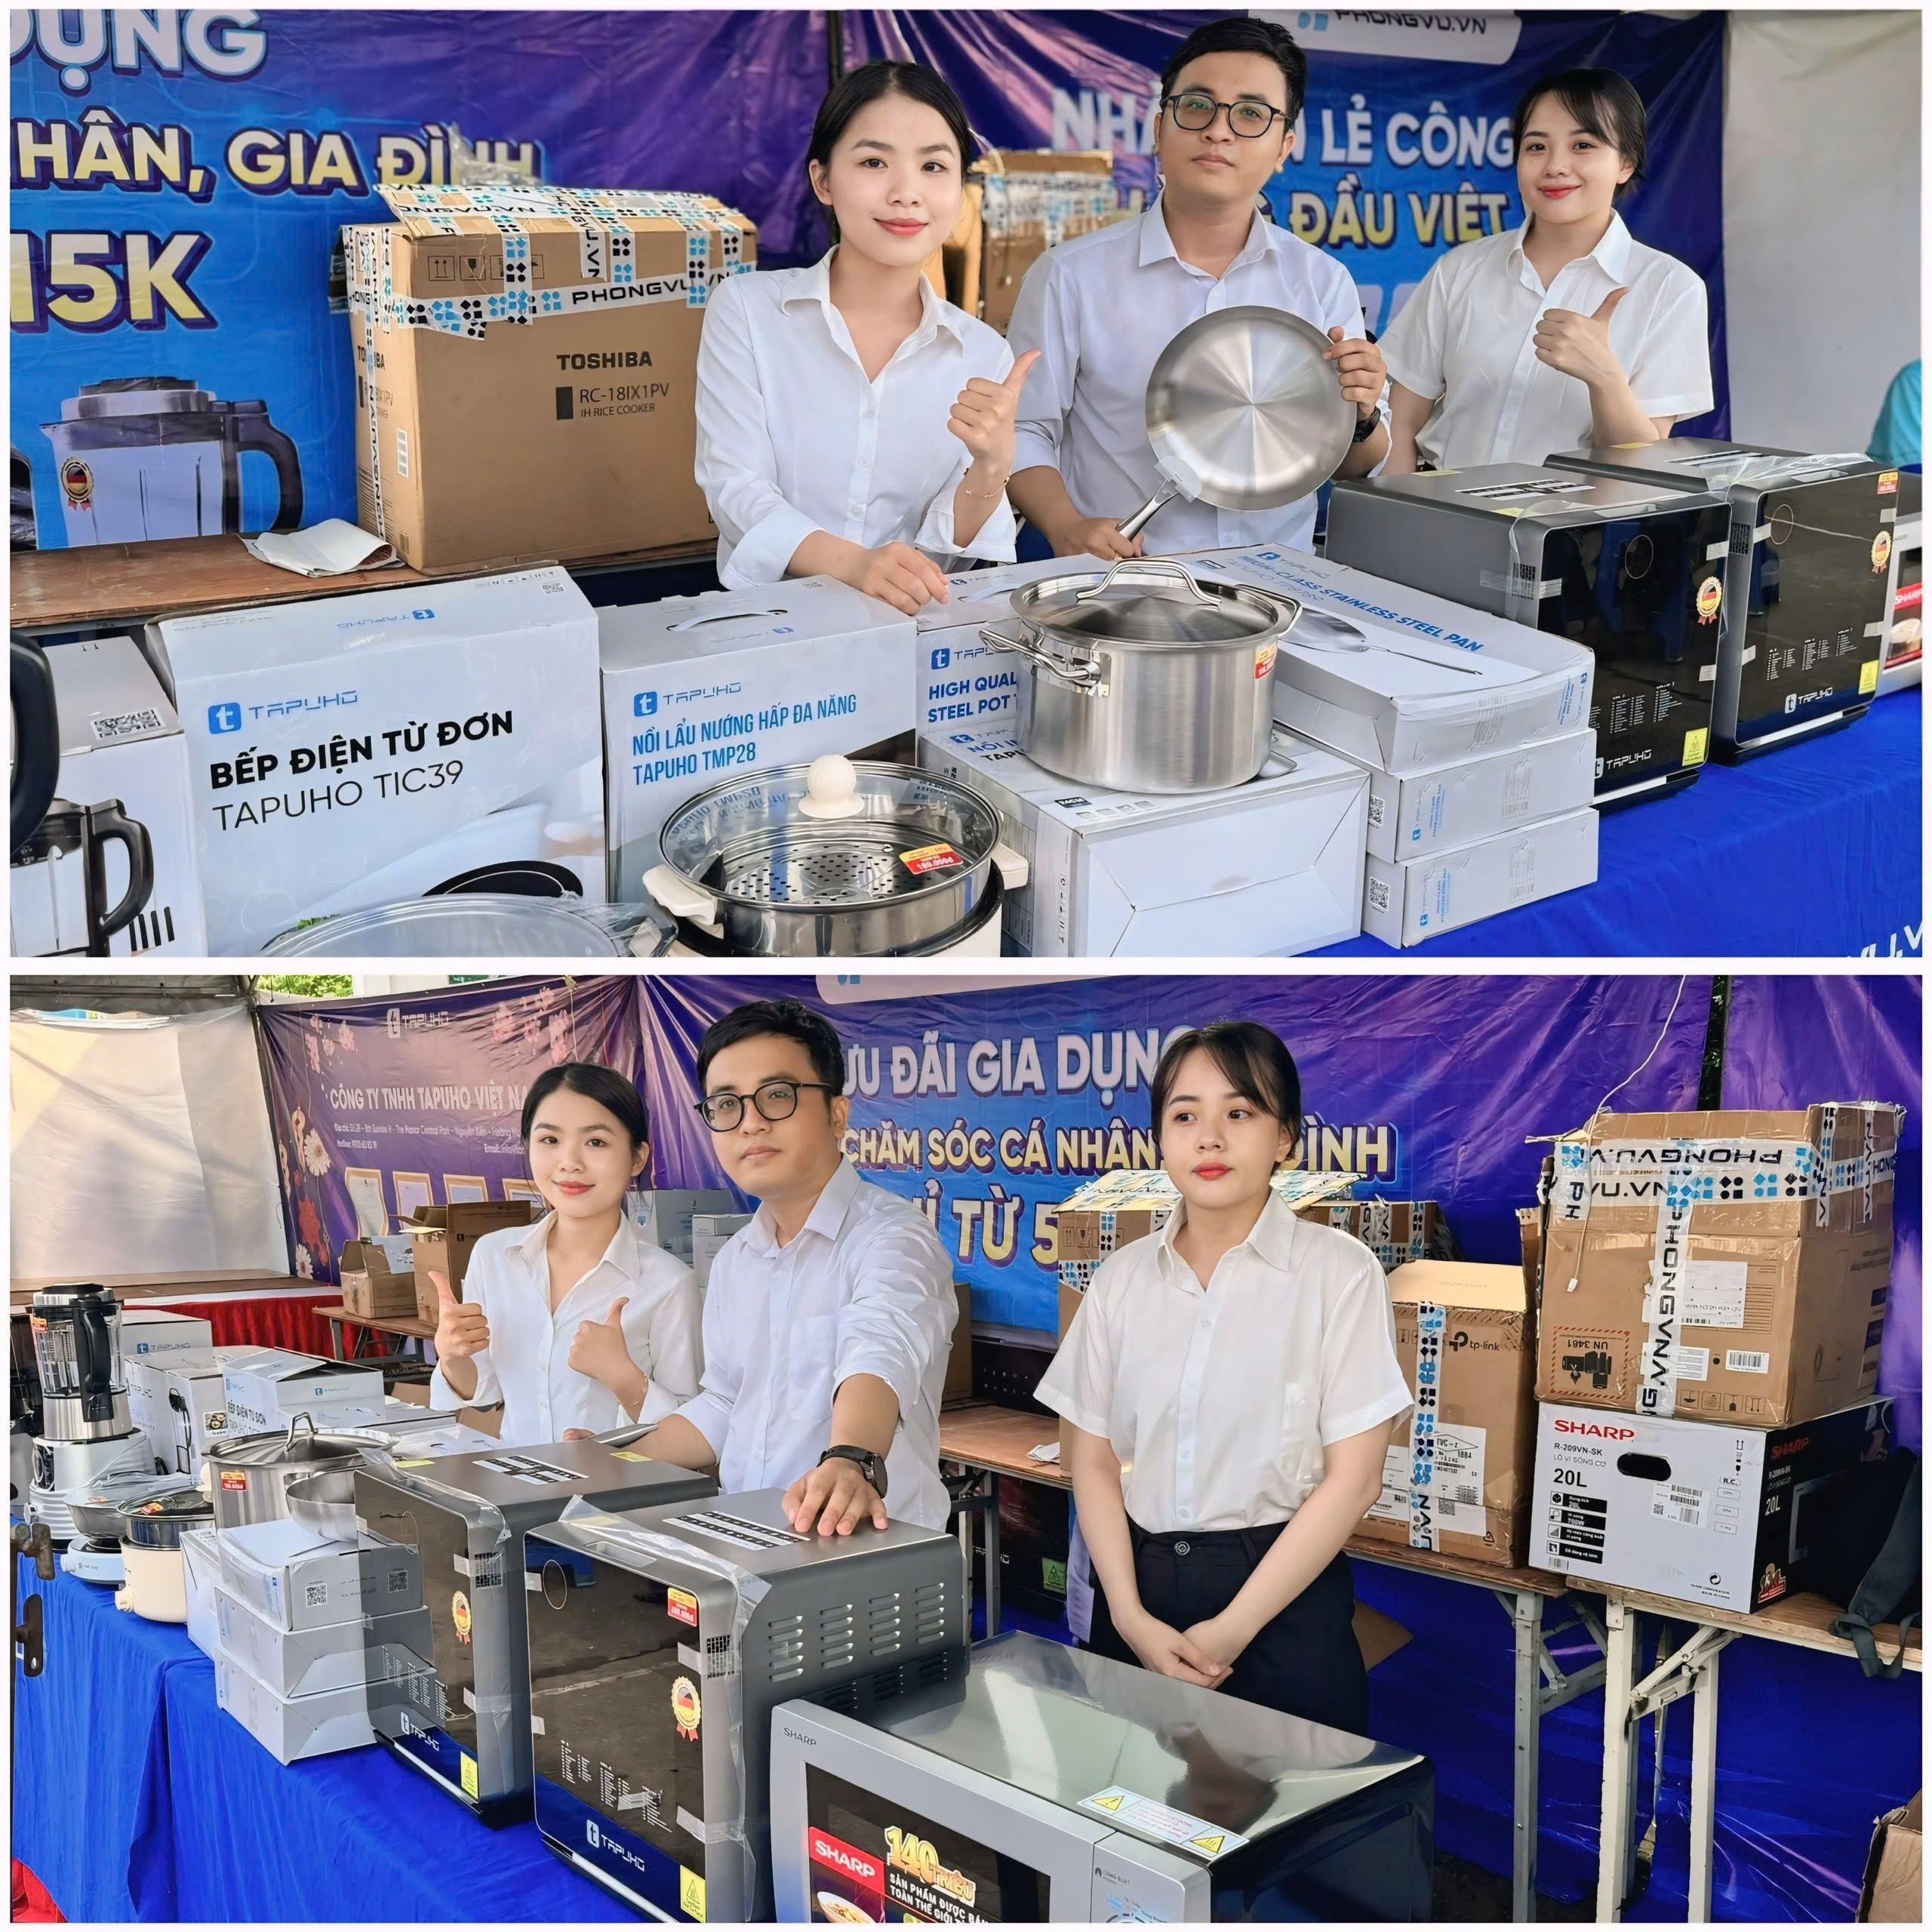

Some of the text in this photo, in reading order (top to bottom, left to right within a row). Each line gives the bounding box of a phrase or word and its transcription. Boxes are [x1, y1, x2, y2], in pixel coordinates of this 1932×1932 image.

[1321, 94, 1374, 164] LẺ
[1386, 100, 1514, 168] CÔNG
[227, 130, 358, 187] GIA
[1289, 172, 1395, 248] ĐẦU
[556, 351, 652, 370] TOSHIBA
[580, 383, 670, 404] RC-18IX1PV
[581, 403, 655, 417] IH RICE COOKER
[1318, 587, 1399, 620] STAINLESS
[1395, 615, 1443, 638] STEEL
[1442, 632, 1485, 652] PAN
[663, 682, 741, 706] TAPUHO
[928, 679, 970, 700] HIGH
[1798, 687, 1834, 705] TAPUHO
[248, 690, 358, 720] TAPUHO
[928, 694, 1011, 723] STEEL POT
[632, 694, 857, 756] NỒI LẨU NƯỚNG HẤP ĐA NĂNG
[210, 710, 514, 789] BẾP ĐIỆN TỪ ĐƠN
[632, 742, 756, 786] TAPUHO TMP28
[1606, 749, 1652, 770] TAPUHO
[212, 759, 464, 832] TAPUHO TIC39
[891, 1030, 957, 1094] ĐÃI
[967, 1037, 1047, 1094] GIA
[1057, 1025, 1181, 1107] DỤN
[330, 1083, 365, 1109] CÔNG
[367, 1088, 379, 1109] TY
[382, 1088, 415, 1109] TNHH
[417, 1086, 470, 1111] TAPUHO
[474, 1079, 503, 1117] VIỆT
[841, 1119, 921, 1165] CHĂM
[928, 1118, 992, 1168] SÓC
[1000, 1118, 1048, 1168] CÁ
[1581, 1148, 1783, 1165] PHONGVU.V
[952, 1183, 1020, 1266] TỪ
[1469, 1340, 1500, 1352] tp-link
[1567, 1340, 1608, 1349] UN 3481
[1554, 1420, 1635, 1441] SHARP
[1554, 1442, 1603, 1457] R-209VN-SK
[1770, 1437, 1810, 1460] SHARP
[1553, 1468, 1587, 1487] 20L
[1764, 1495, 1781, 1516] 20L
[783, 1727, 817, 1747] SHARP
[601, 1835, 645, 1872] TAPUHO
[814, 1839, 875, 1878] SHARP
[884, 1826, 939, 1884] 140
[889, 1884, 914, 1906] TOÀN
[915, 1897, 933, 1915] THẾ
